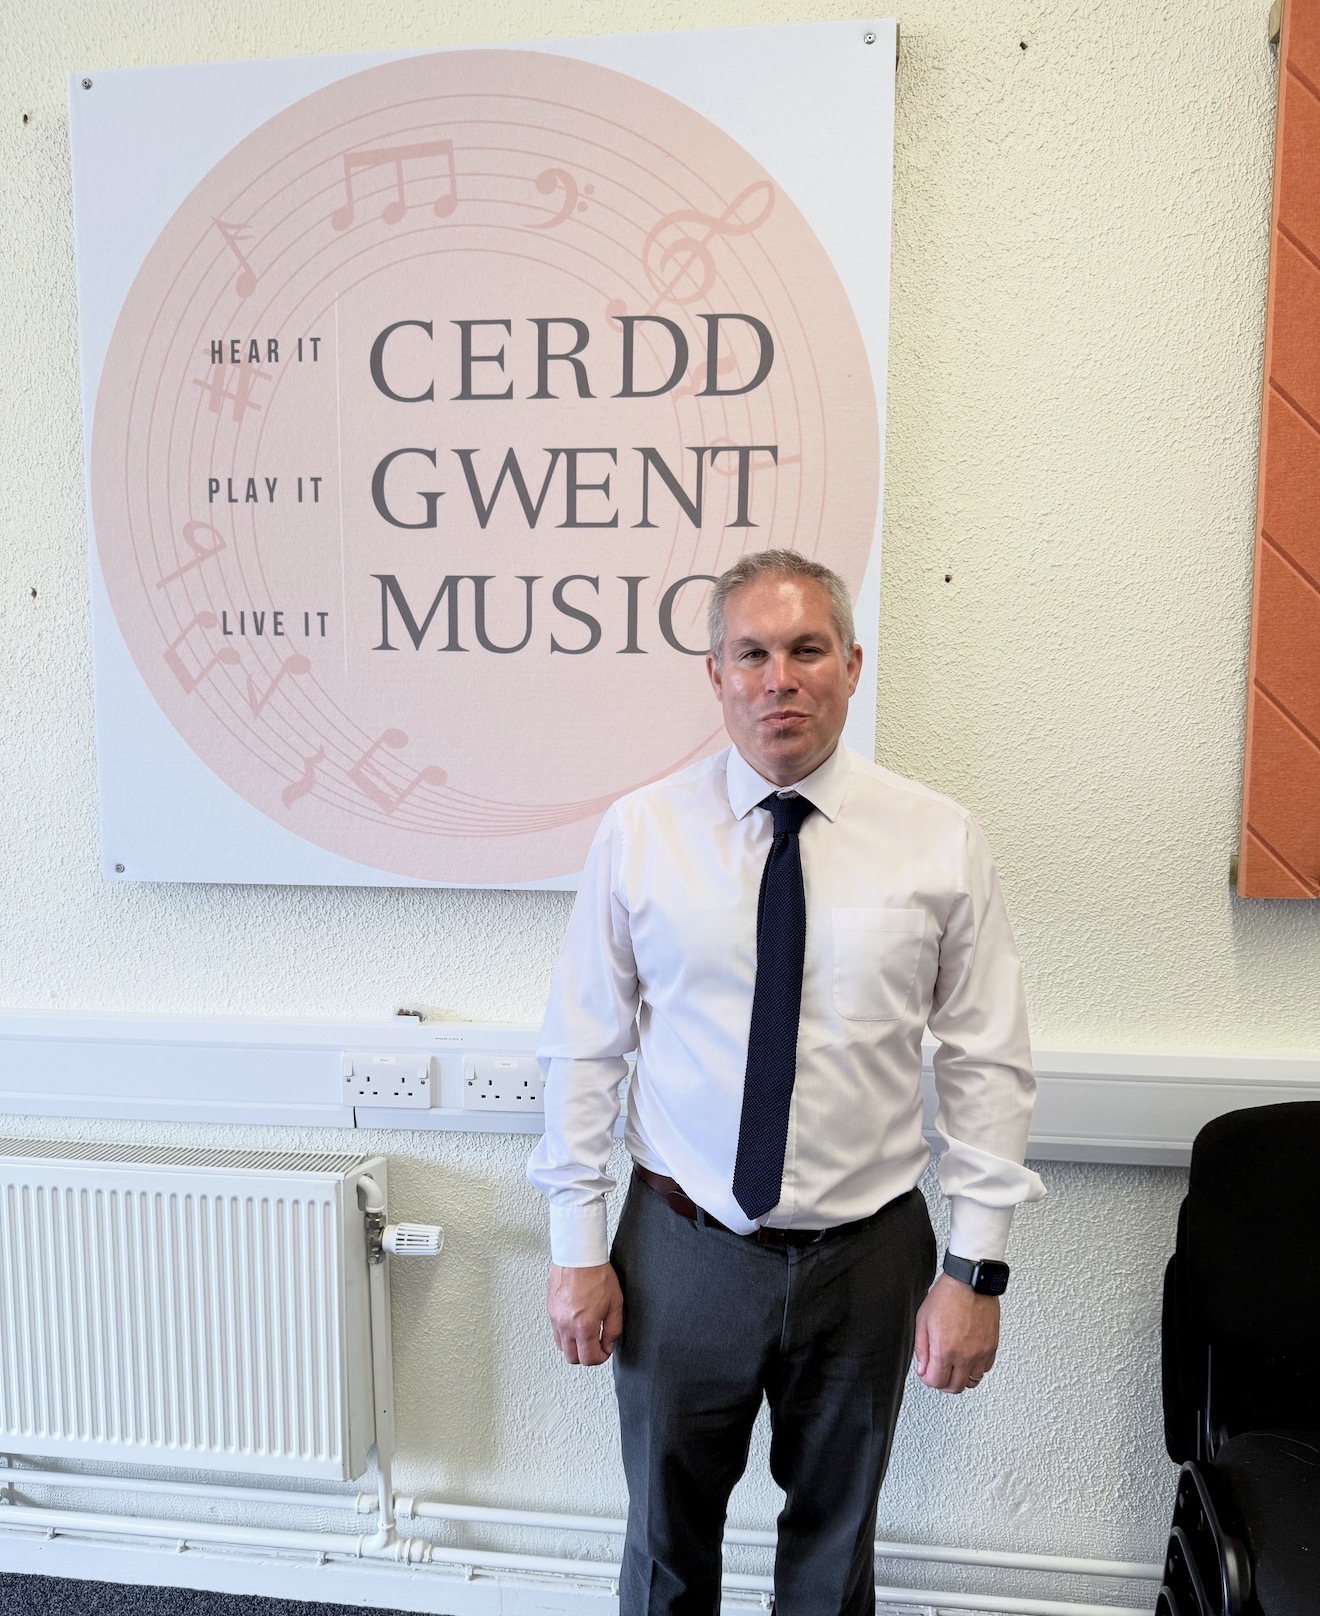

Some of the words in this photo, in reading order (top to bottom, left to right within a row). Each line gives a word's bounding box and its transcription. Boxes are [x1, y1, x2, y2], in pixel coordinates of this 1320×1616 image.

[210, 338, 279, 365] HEAR
[297, 337, 322, 363] IT
[369, 313, 775, 403] CERDD
[208, 477, 279, 503] PLAY
[297, 476, 323, 503] IT
[371, 445, 779, 530] GWENT
[222, 610, 285, 637] LIVE
[304, 611, 329, 637] IT
[369, 574, 715, 655] MUSIC
